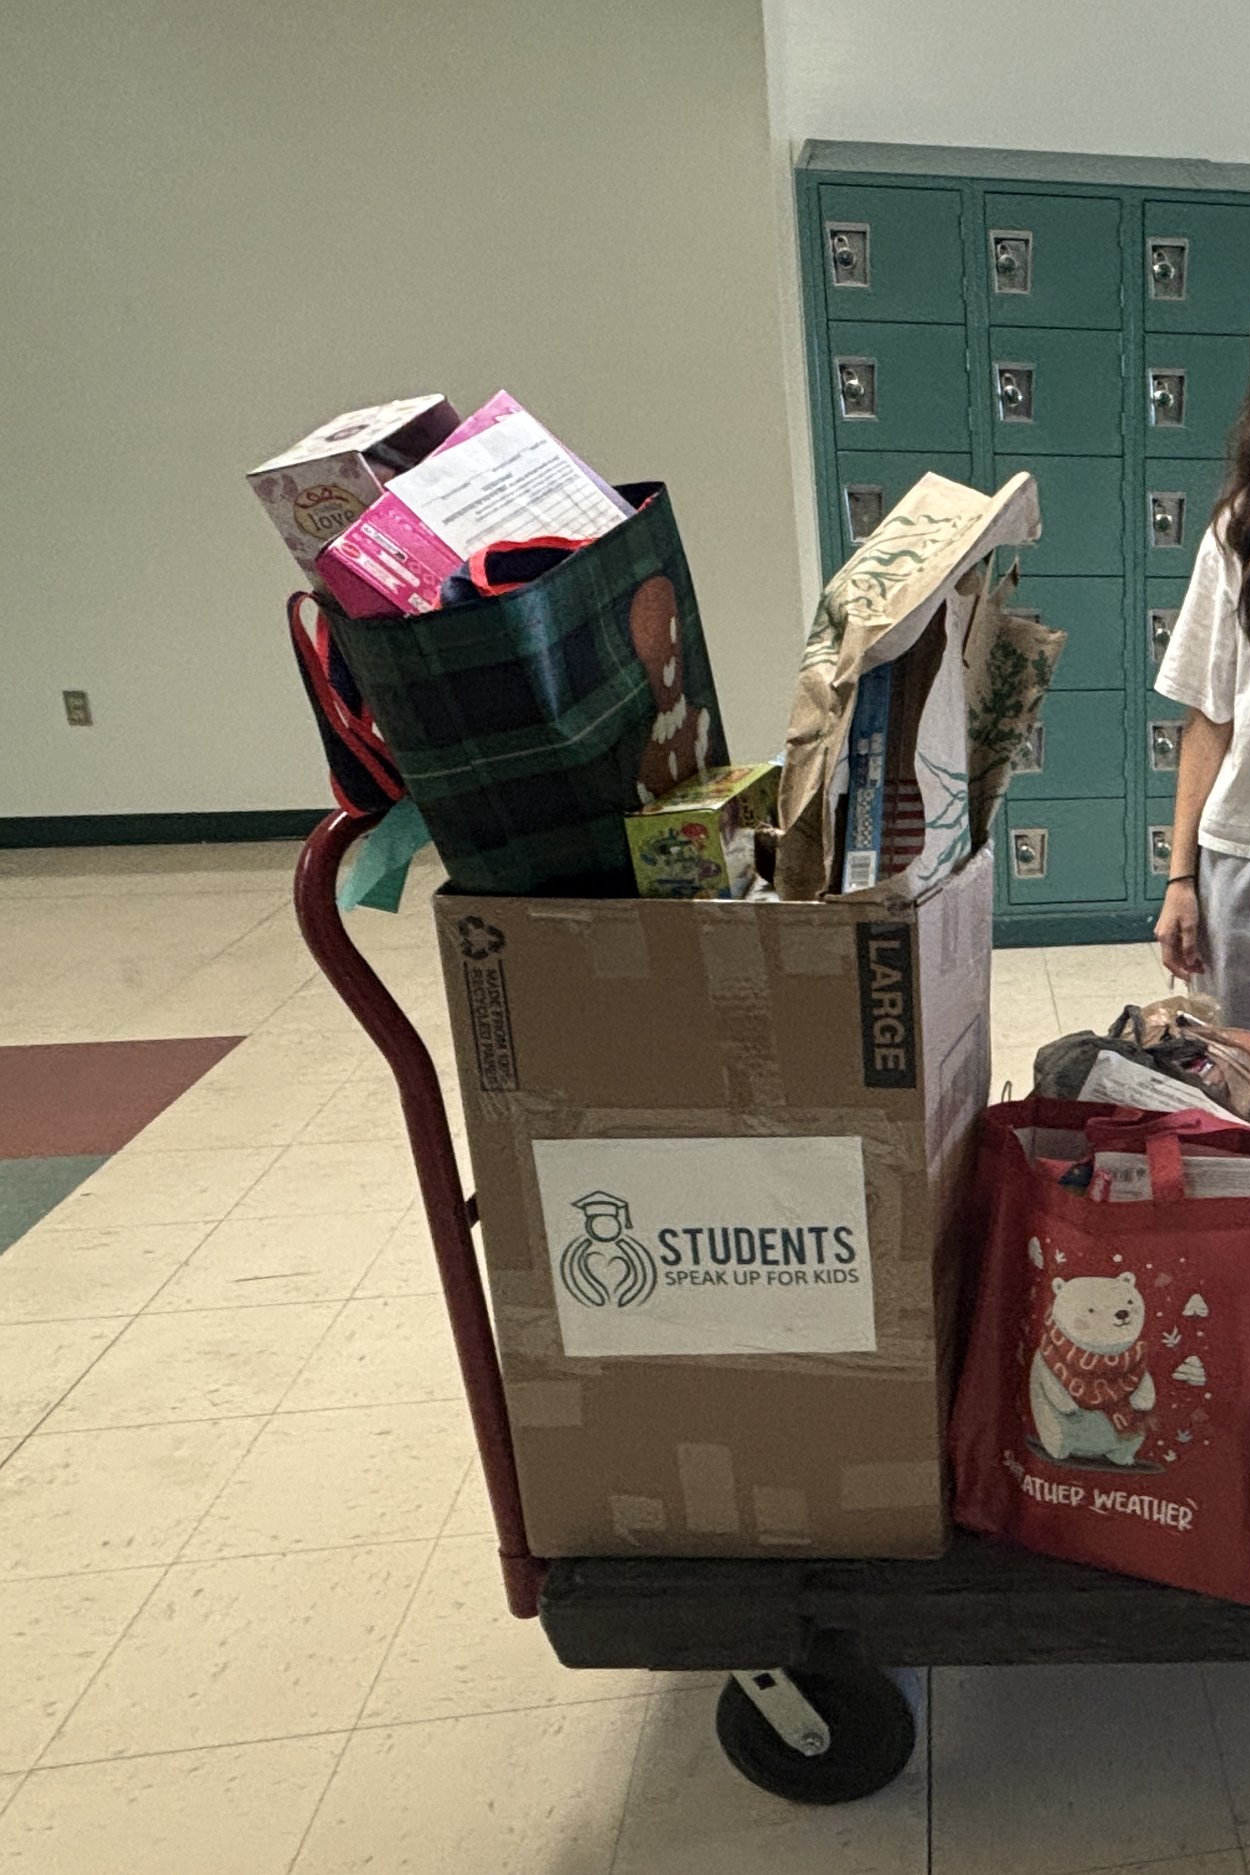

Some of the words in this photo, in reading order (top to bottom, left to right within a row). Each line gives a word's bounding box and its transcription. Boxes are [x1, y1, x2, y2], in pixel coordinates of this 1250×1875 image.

[307, 510, 354, 531] love
[868, 940, 906, 1071] LARGE
[658, 1226, 856, 1266] STUDENTS
[665, 1270, 728, 1286] SPEAK
[733, 1270, 761, 1286] UP
[767, 1270, 808, 1286] FOR
[813, 1269, 860, 1285] KIDS
[1093, 1488, 1193, 1531] WEATHER
